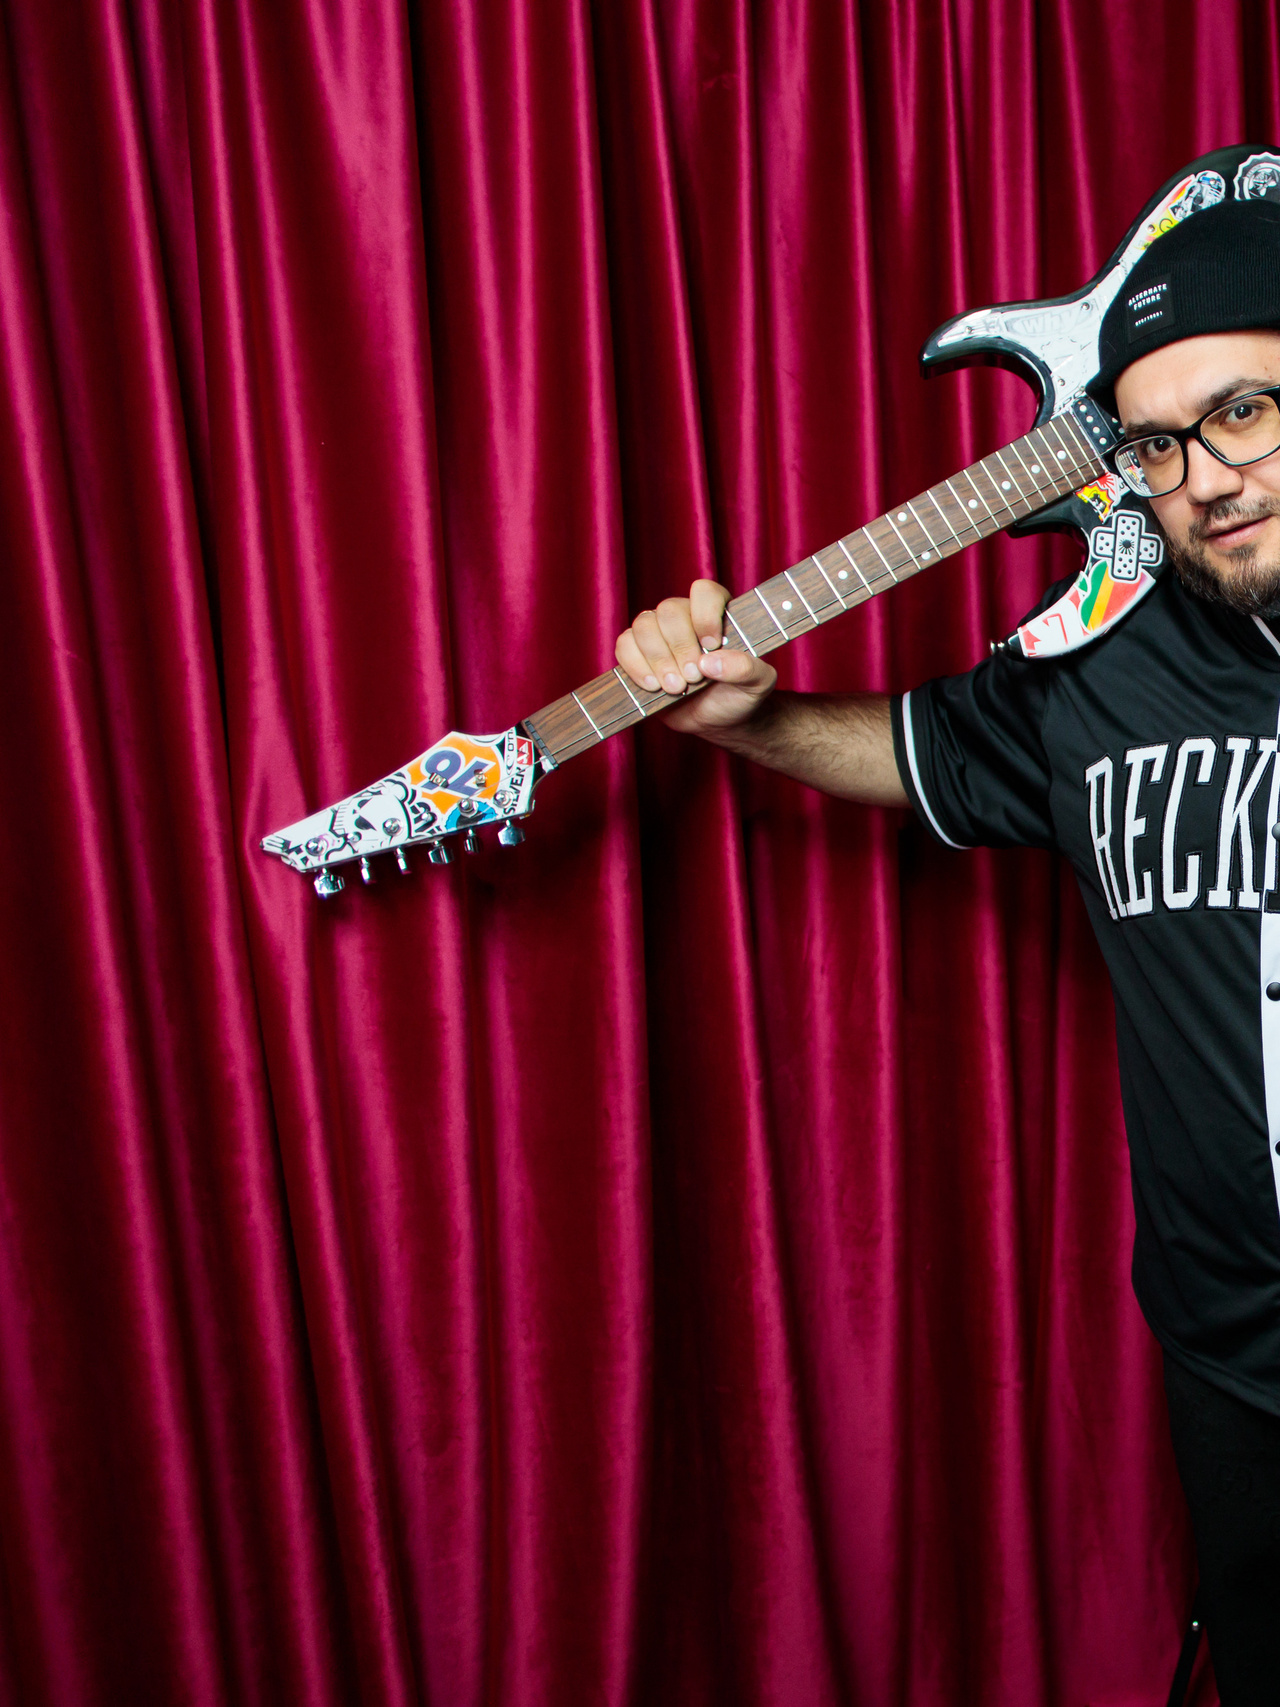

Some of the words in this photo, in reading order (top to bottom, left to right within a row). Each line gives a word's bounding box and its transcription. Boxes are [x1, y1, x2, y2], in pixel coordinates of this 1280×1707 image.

[1128, 283, 1167, 307] ALTERNATE
[1133, 293, 1161, 311] FUTURE
[420, 749, 489, 796] 76
